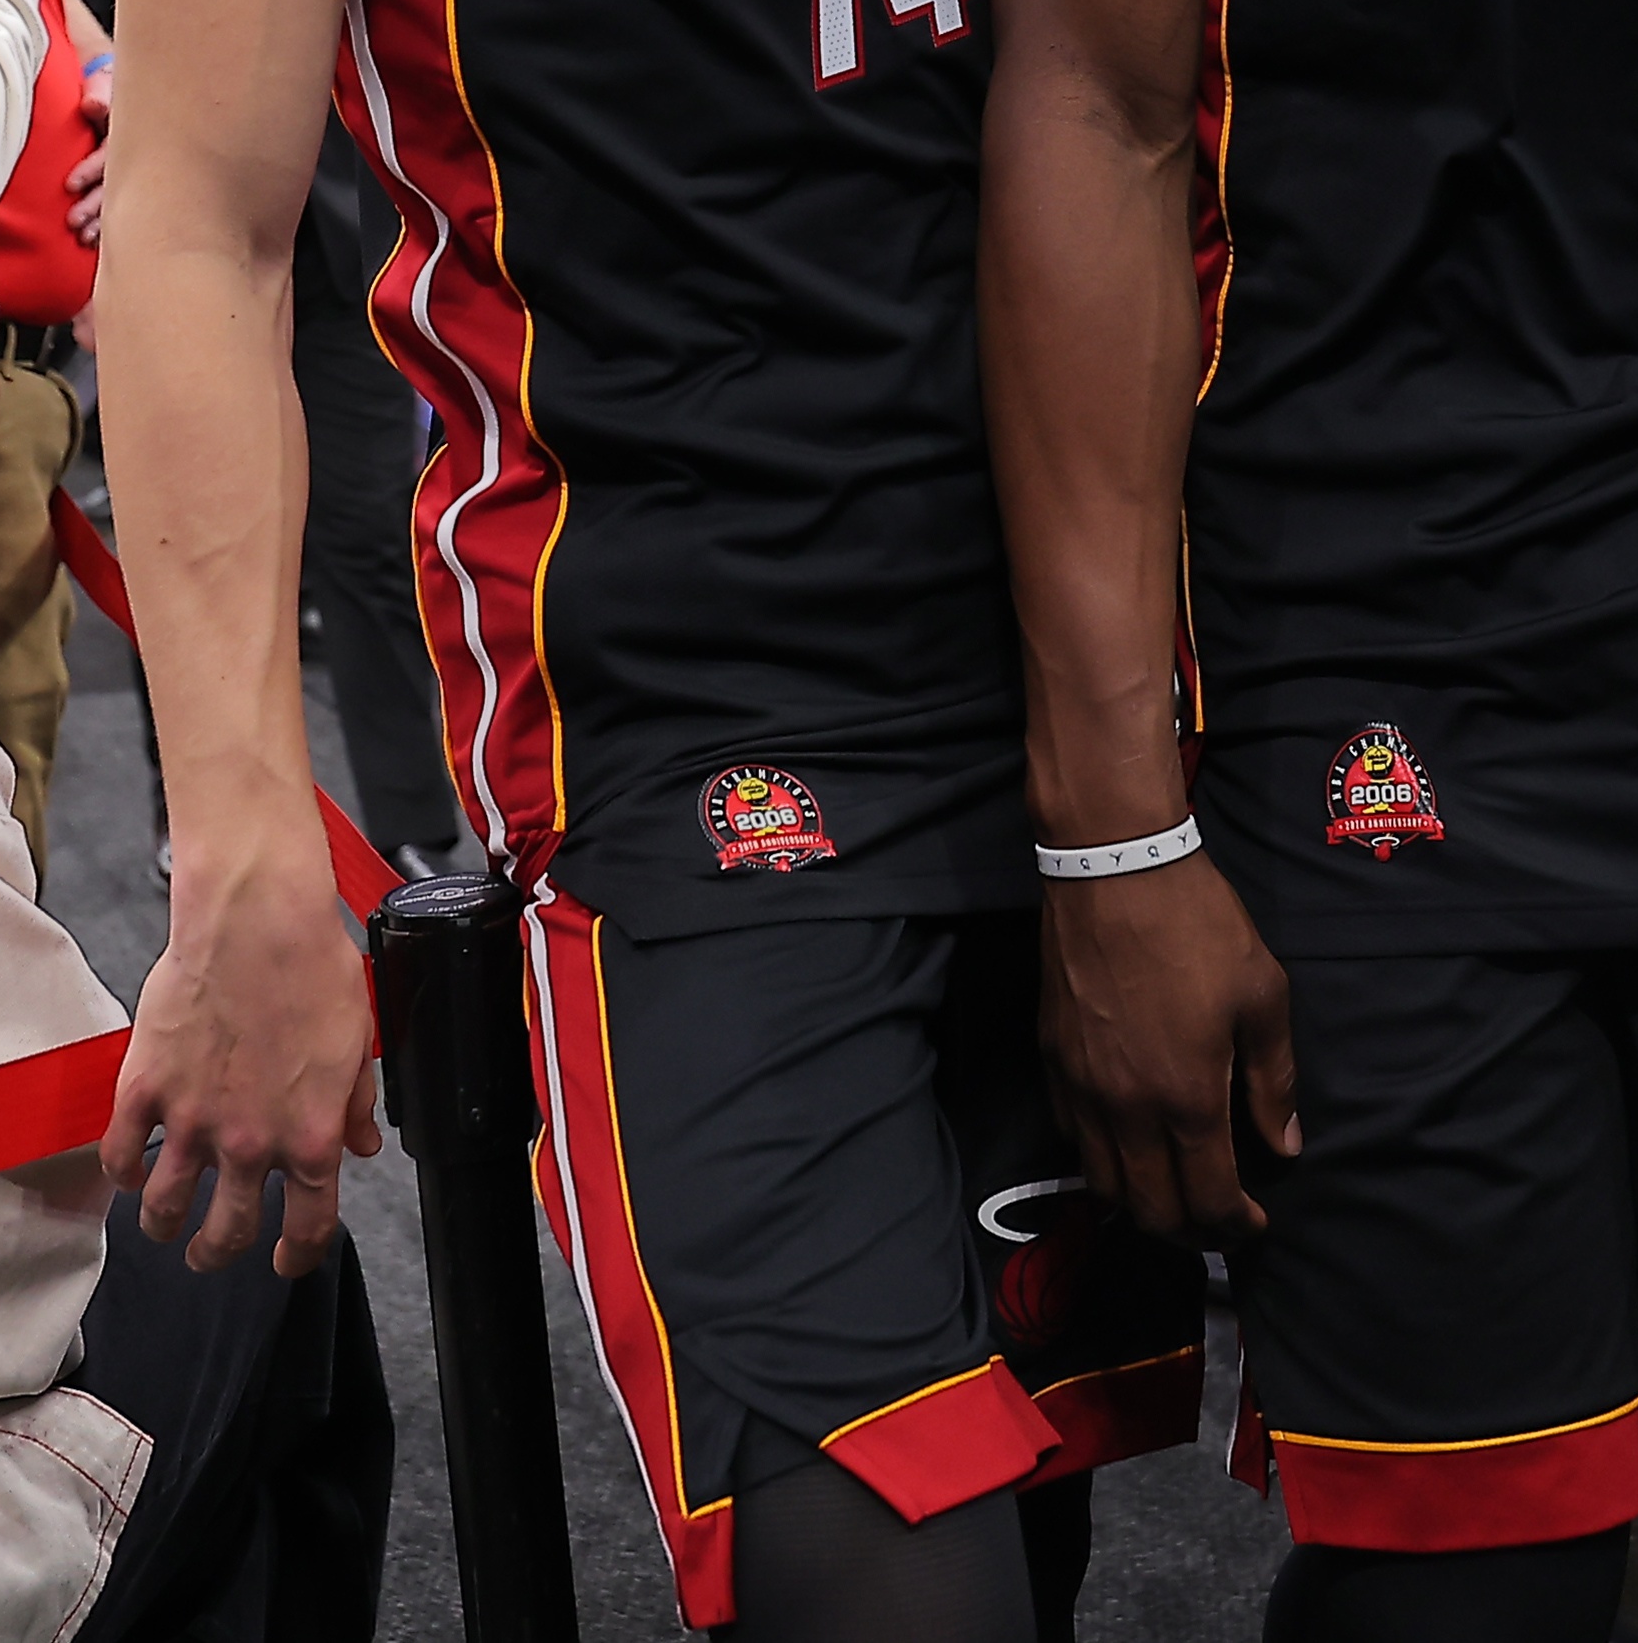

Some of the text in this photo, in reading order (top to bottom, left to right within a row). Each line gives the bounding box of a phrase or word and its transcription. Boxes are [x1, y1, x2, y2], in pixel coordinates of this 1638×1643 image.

[720, 767, 817, 819] CHAMPIONS
[1350, 783, 1412, 806] 2006
[733, 807, 799, 832] 2006
[1367, 817, 1423, 829] ANNIVERSARY
